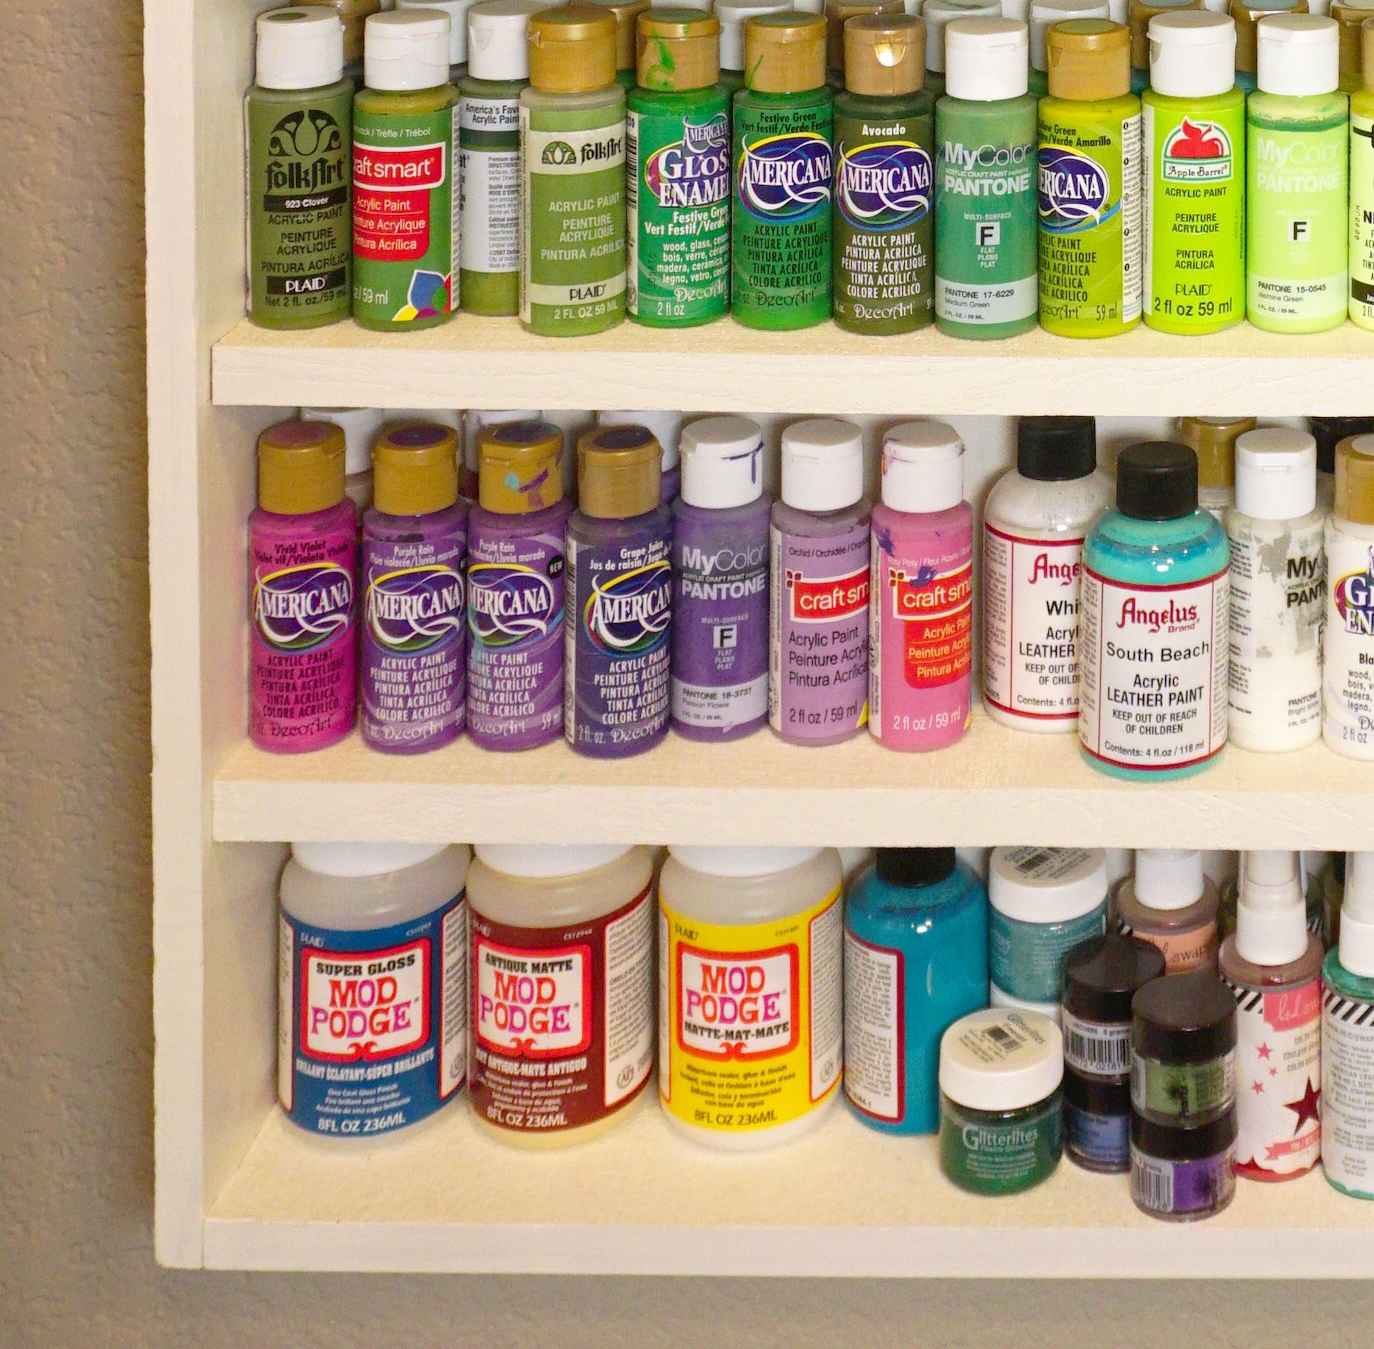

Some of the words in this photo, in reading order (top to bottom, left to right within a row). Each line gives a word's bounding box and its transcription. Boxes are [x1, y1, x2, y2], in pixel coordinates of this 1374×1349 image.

[760, 112, 794, 124] Festive
[796, 111, 817, 122] Green
[862, 124, 906, 136] Avocado
[944, 141, 1032, 170] MyColor
[373, 159, 430, 178] smart
[741, 153, 831, 187] AMERICANA
[1167, 166, 1195, 178] Apple
[1197, 164, 1224, 178] Barrel
[285, 198, 300, 209] 923
[302, 195, 329, 207] Clover
[285, 278, 326, 293] PLAID
[394, 546, 417, 557] Purple
[419, 545, 434, 555] Rain
[620, 547, 647, 560] Grape
[682, 574, 766, 600] PANTONE
[800, 590, 845, 611] craft
[1116, 597, 1198, 634] Angelus
[1168, 624, 1195, 634] Brand
[1106, 641, 1154, 662] South
[1160, 640, 1210, 662] Beach
[1133, 674, 1179, 691] Acrylic
[1107, 687, 1163, 707] LEATHER
[1169, 686, 1204, 707] PAINT
[1112, 709, 1132, 720] KEEP
[1135, 711, 1153, 722] OUT
[1156, 711, 1168, 722] OF
[1170, 709, 1197, 721] REACH
[1126, 724, 1137, 734] OF
[1139, 723, 1183, 735] CHILDREN
[316, 961, 363, 976] SUPER
[368, 954, 416, 974] GLOSS
[485, 953, 527, 973] ANTIQUE
[531, 957, 573, 973] MATTE
[493, 971, 557, 1005] MOD
[700, 964, 765, 996] MOD
[329, 975, 398, 1008] MOD
[480, 995, 571, 1034] PODGE
[686, 989, 781, 1024] PODGE
[311, 1001, 412, 1039] PODGE
[684, 1021, 789, 1041] MATTE-MAT-MATE
[341, 1119, 360, 1133] OZ
[363, 1113, 406, 1131] 236ML
